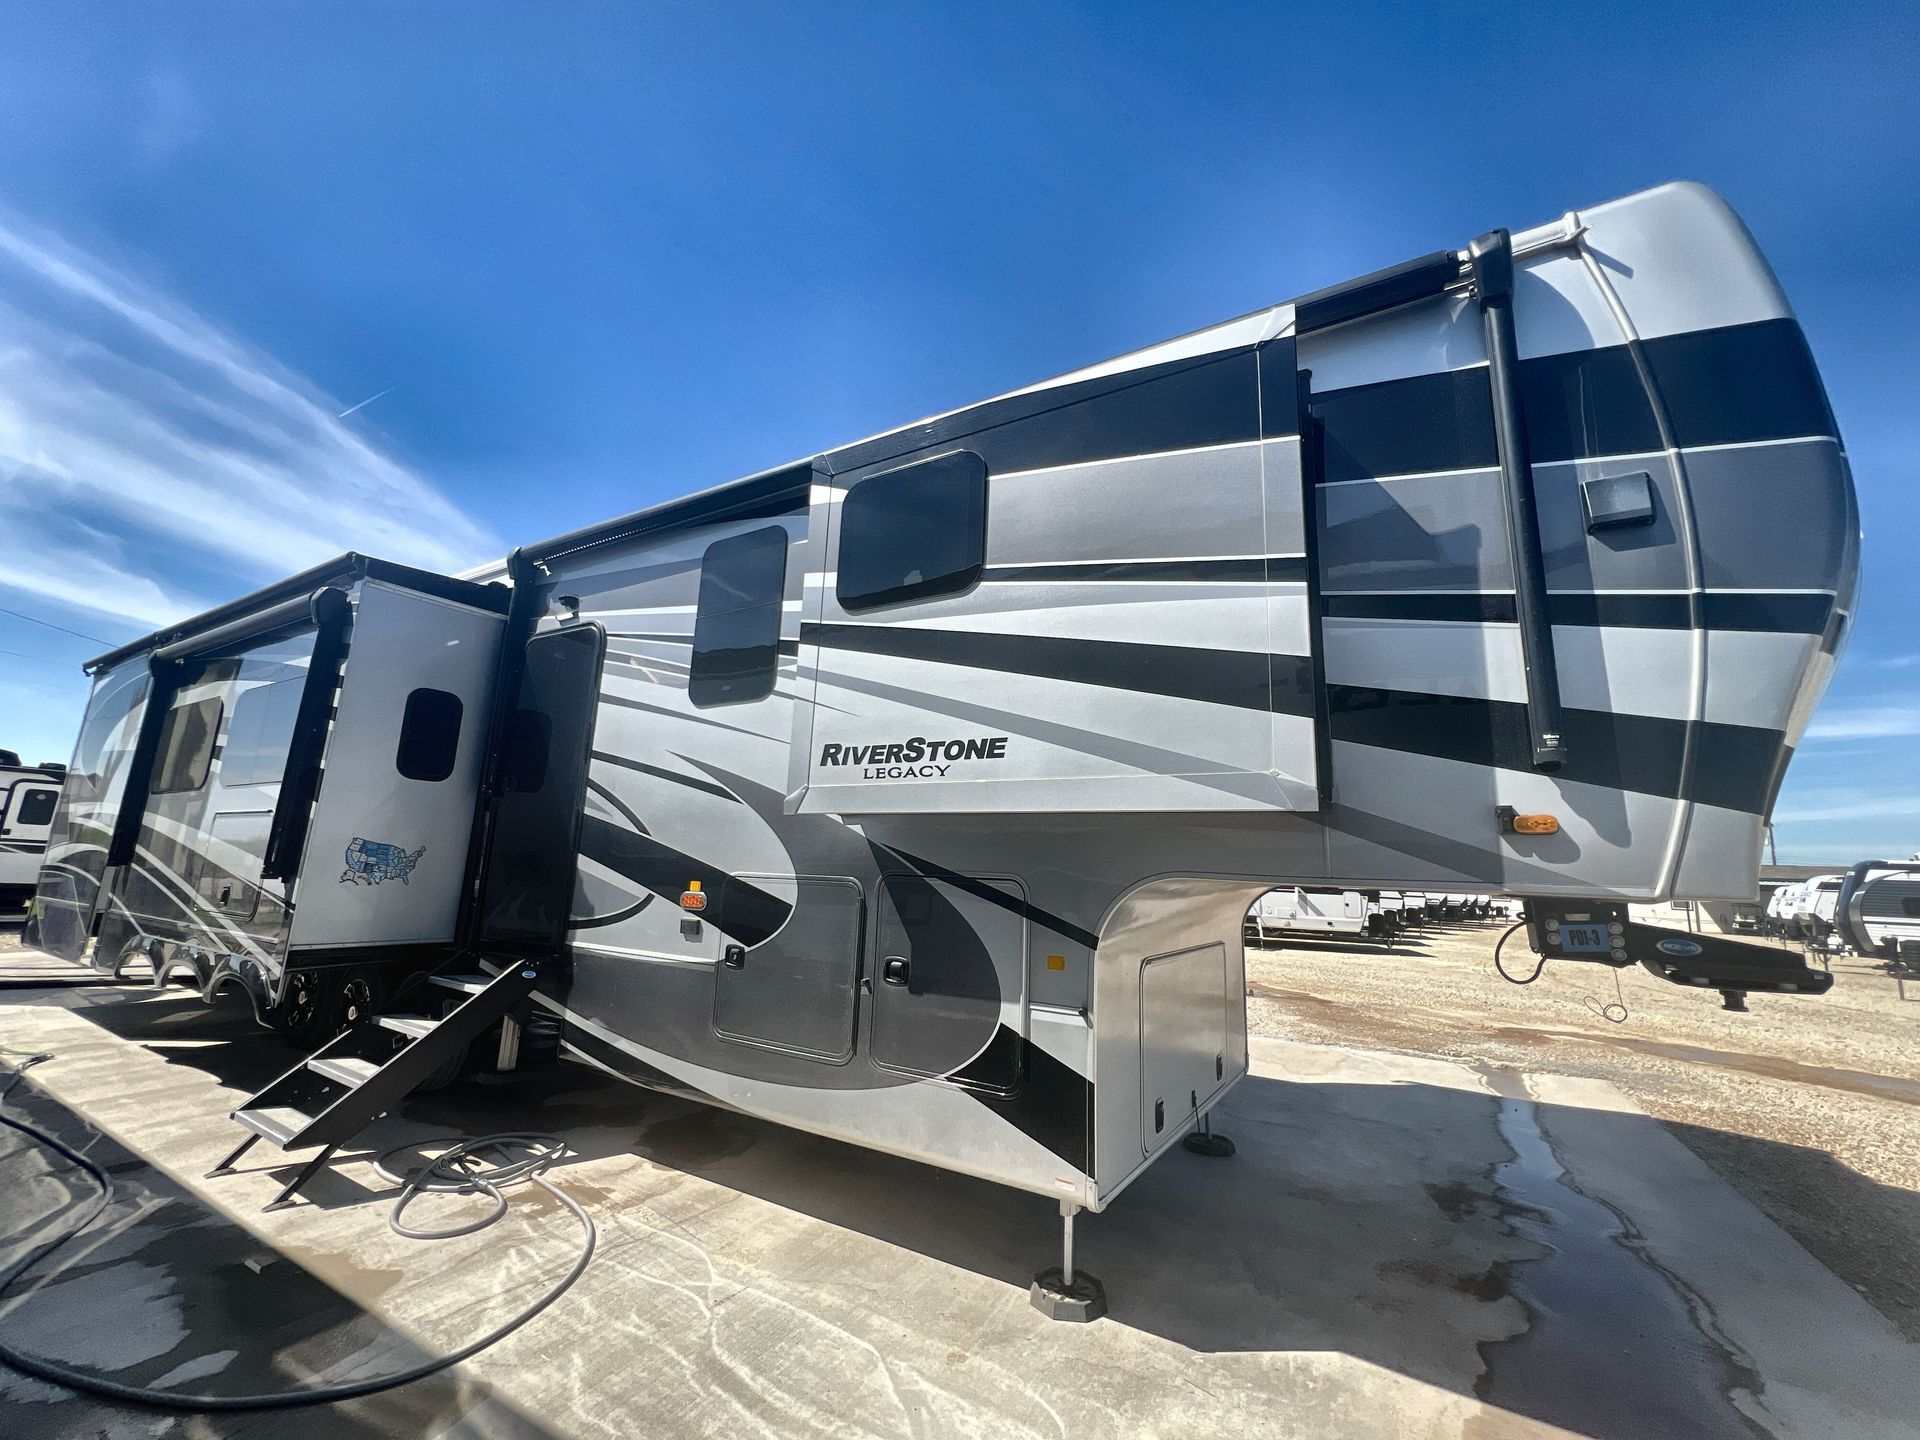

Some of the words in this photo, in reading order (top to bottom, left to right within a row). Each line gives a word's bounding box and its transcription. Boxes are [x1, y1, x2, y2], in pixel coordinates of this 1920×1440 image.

[820, 737, 1008, 766] RIVERSTONE
[863, 764, 951, 779] LEGACY
[1568, 928, 1601, 946] PDI-3
